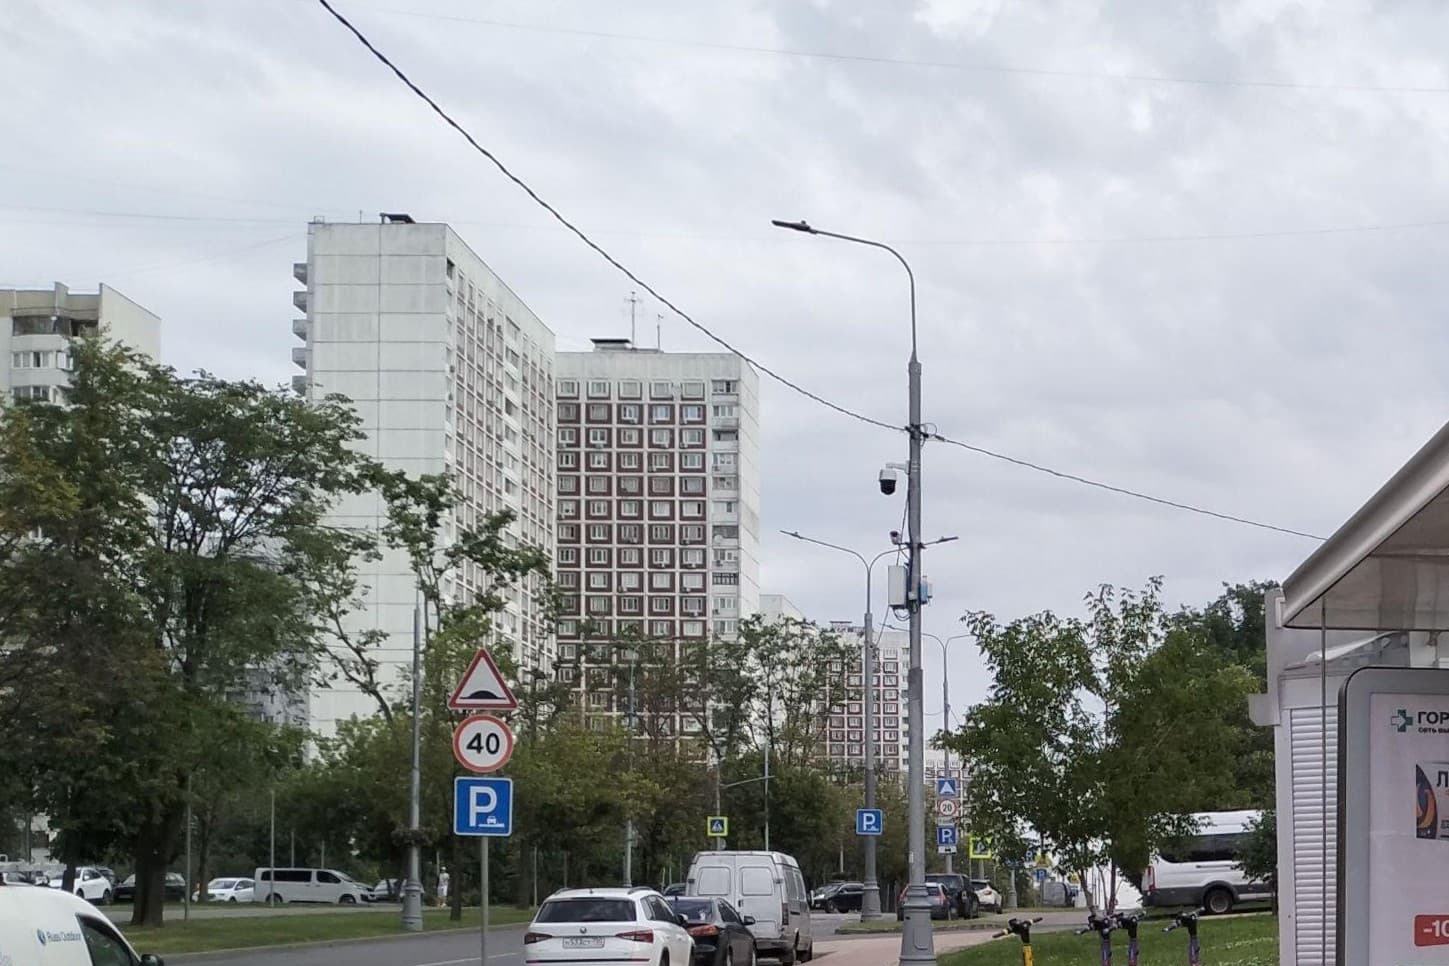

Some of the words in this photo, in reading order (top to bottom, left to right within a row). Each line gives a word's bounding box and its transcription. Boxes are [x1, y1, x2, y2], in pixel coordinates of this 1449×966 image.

[466, 732, 500, 754] 40
[469, 785, 498, 827] P
[942, 803, 953, 812] 20
[863, 812, 876, 831] P
[942, 828, 953, 843] P
